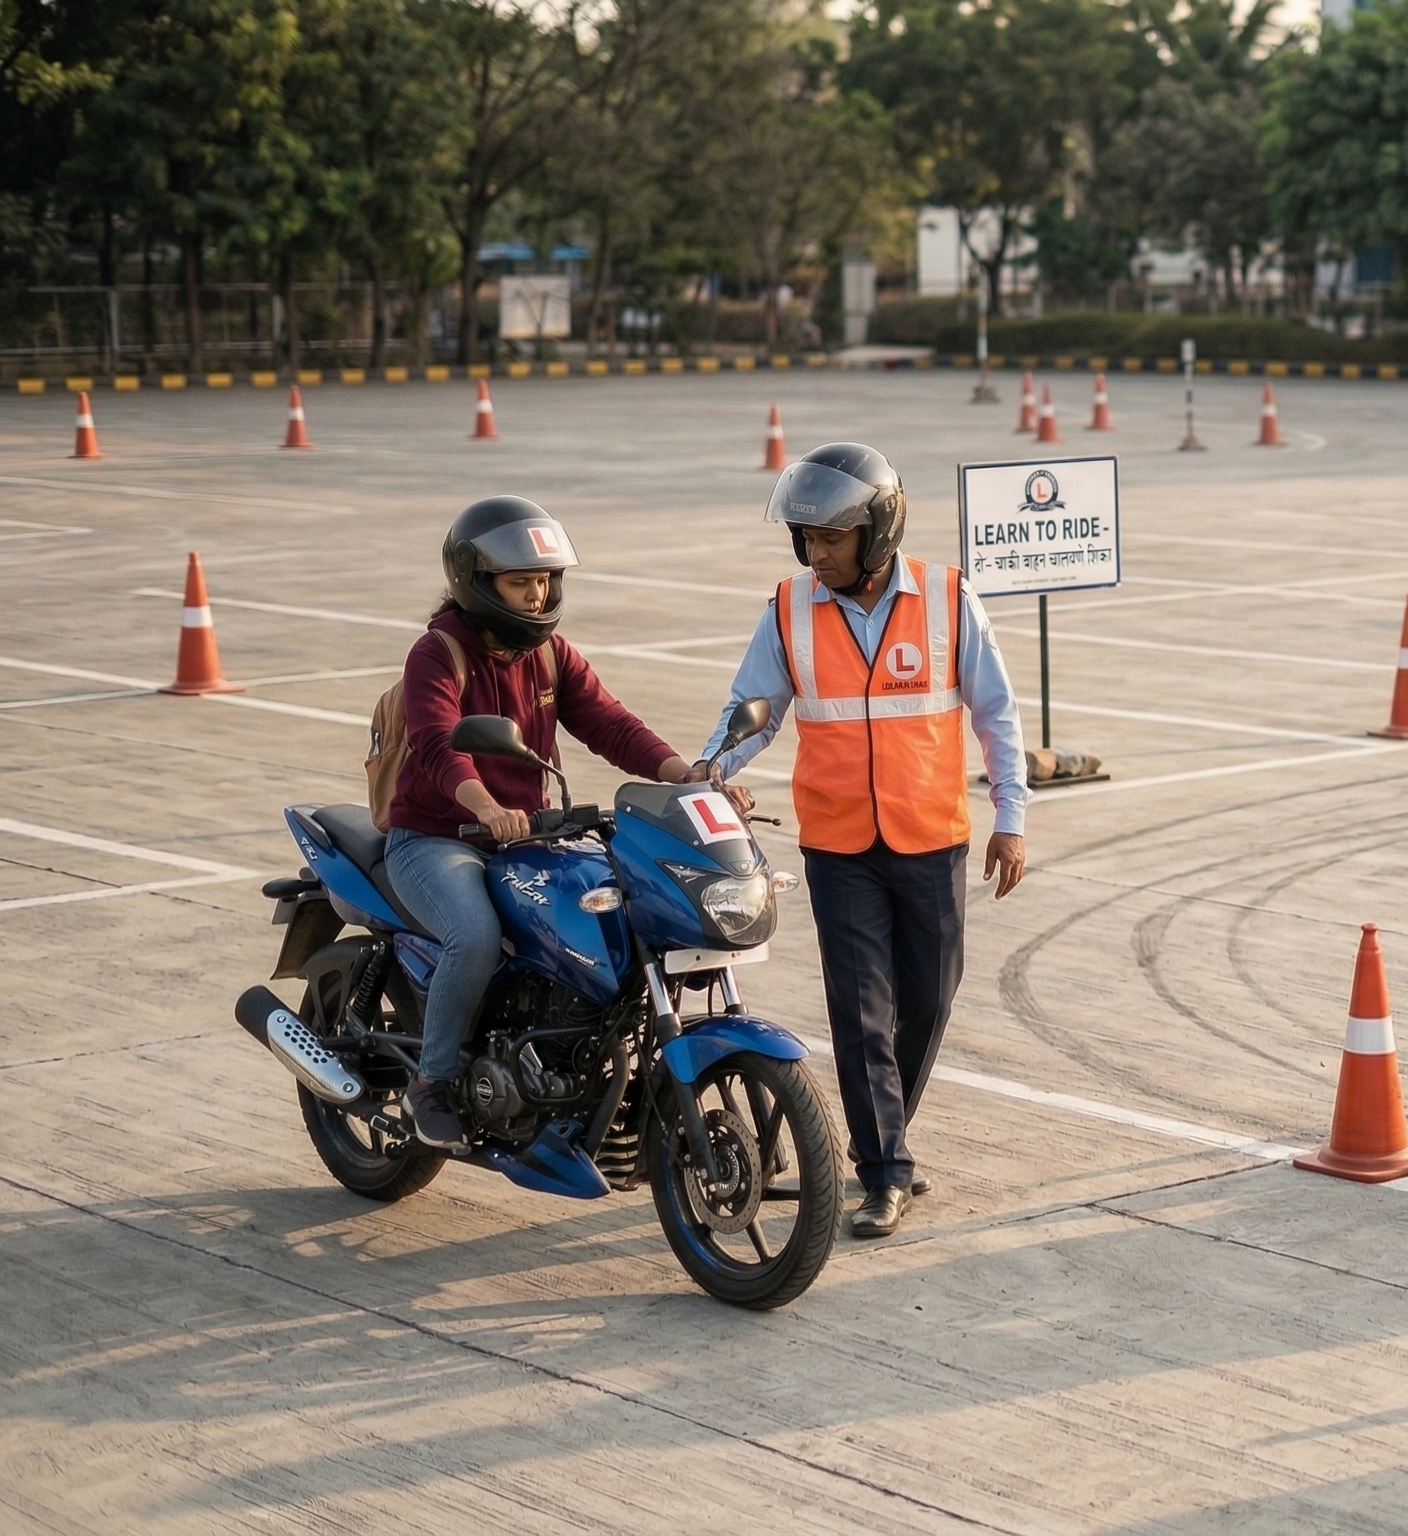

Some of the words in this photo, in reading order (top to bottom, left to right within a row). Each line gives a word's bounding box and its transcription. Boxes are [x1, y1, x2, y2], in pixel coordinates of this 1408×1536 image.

[1037, 482, 1047, 499] L
[531, 529, 558, 554] L
[974, 521, 1030, 546] LEARN
[1035, 519, 1057, 541] TO
[895, 648, 915, 672] L
[692, 798, 742, 835] L
